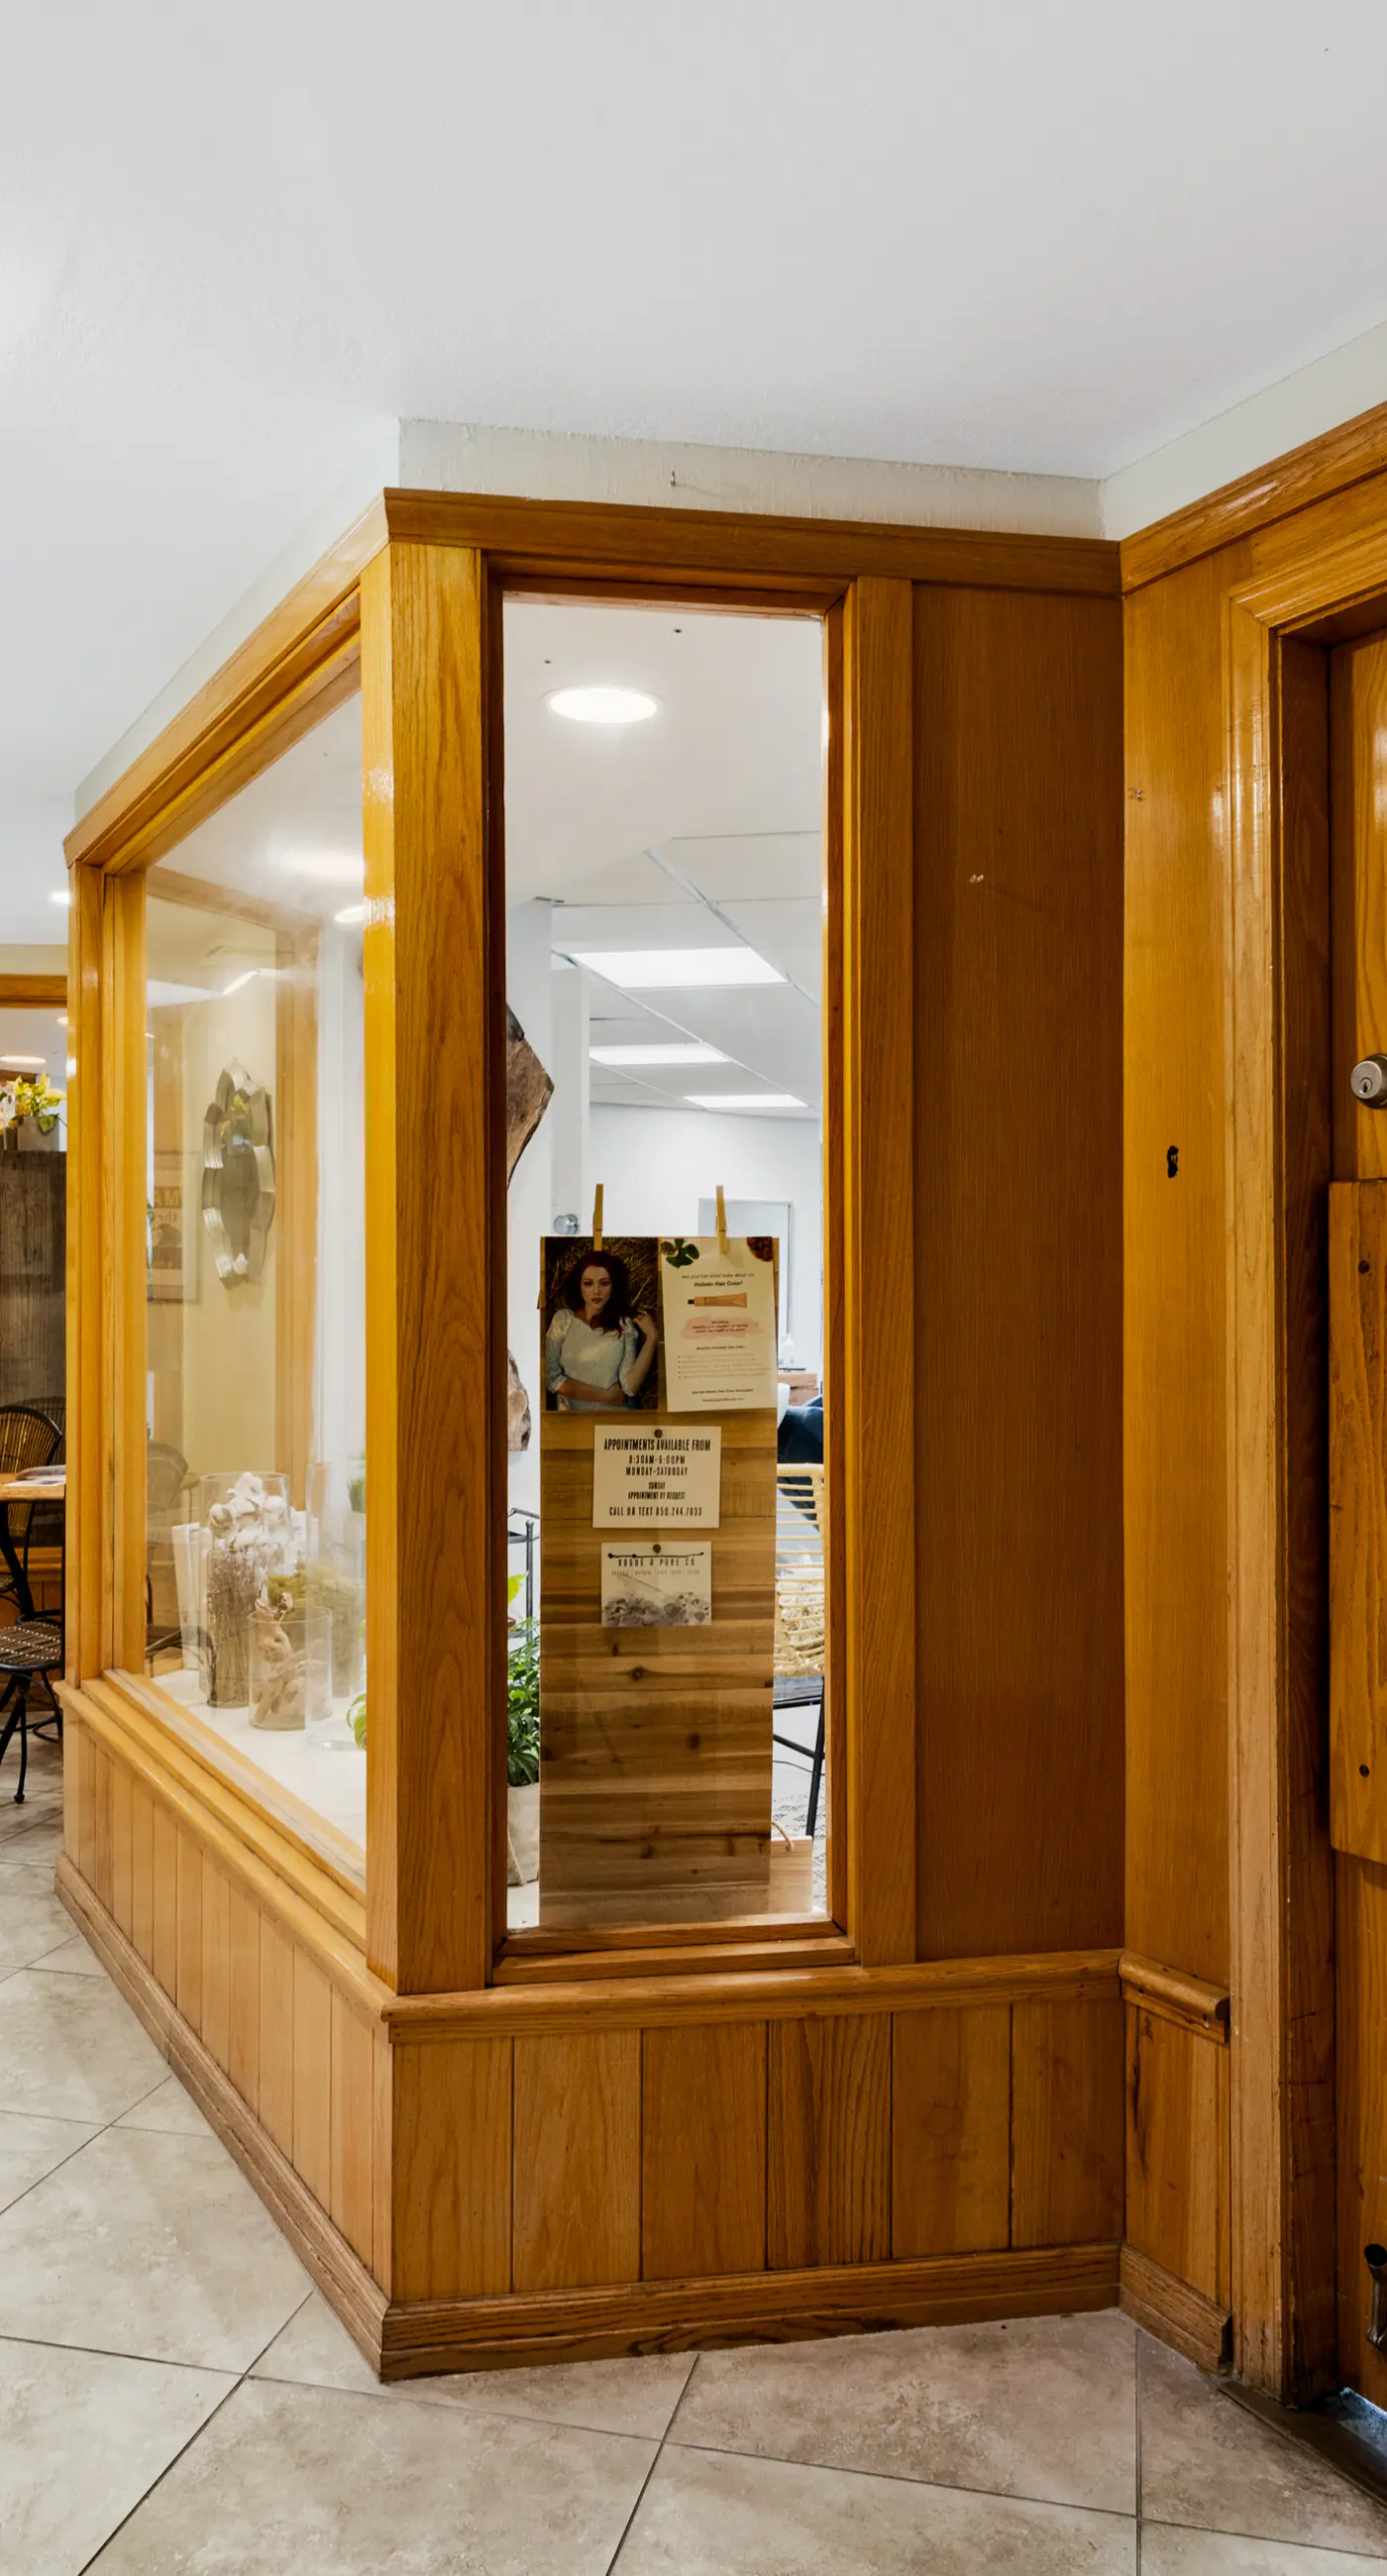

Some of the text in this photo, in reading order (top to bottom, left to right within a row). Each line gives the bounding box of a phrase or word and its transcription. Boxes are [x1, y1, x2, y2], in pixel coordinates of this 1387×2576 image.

[603, 1439, 711, 1451] APPOINTMENTS AVAILABLE FROM
[625, 1466, 688, 1476] MONDAY-SATURDAY
[627, 1491, 686, 1500] APPOINTMENT BY REQUEST
[609, 1507, 624, 1517] CALL
[627, 1507, 636, 1517] OR
[638, 1507, 653, 1517] TEXT
